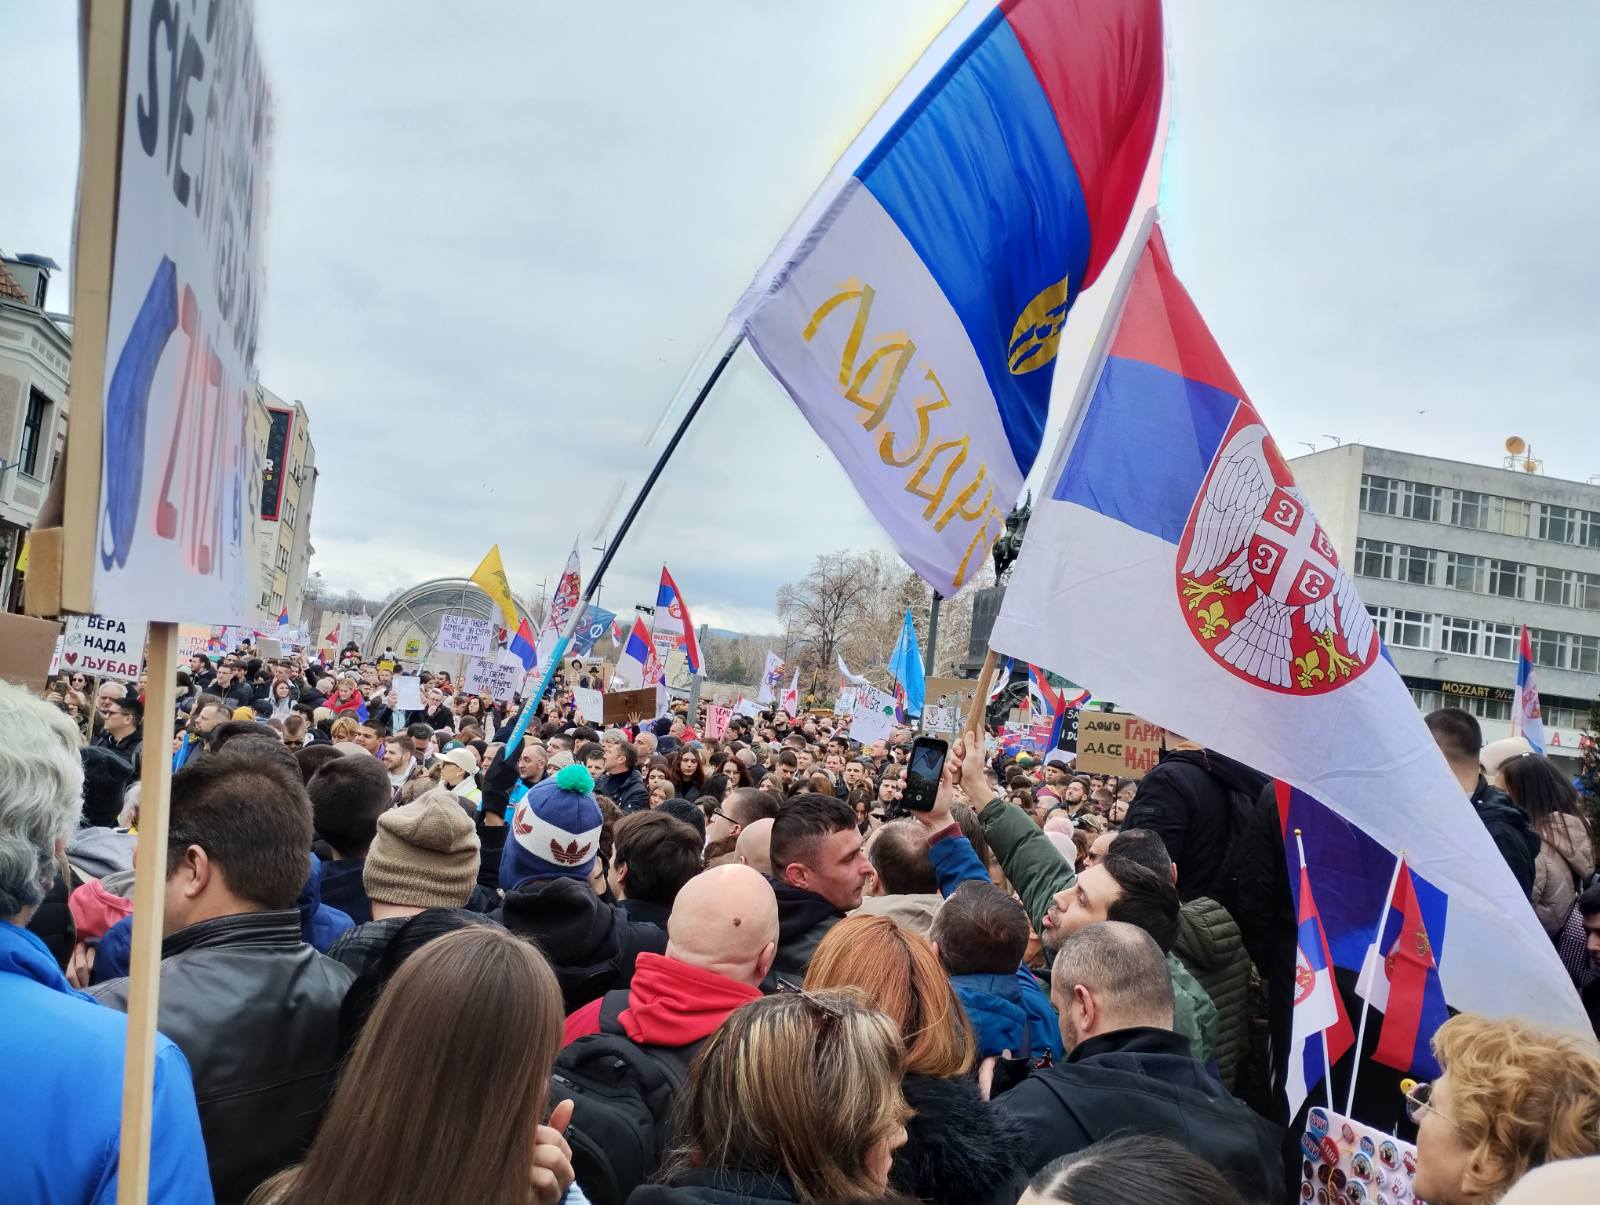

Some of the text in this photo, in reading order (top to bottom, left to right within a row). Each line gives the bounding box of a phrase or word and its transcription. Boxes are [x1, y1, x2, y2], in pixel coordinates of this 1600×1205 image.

[87, 614, 126, 634] ВЕРА
[84, 635, 126, 654] НАДА
[81, 656, 138, 676] ЉУБАВ
[1441, 682, 1489, 697] MOZZART
[1107, 743, 1122, 756] СЕ
